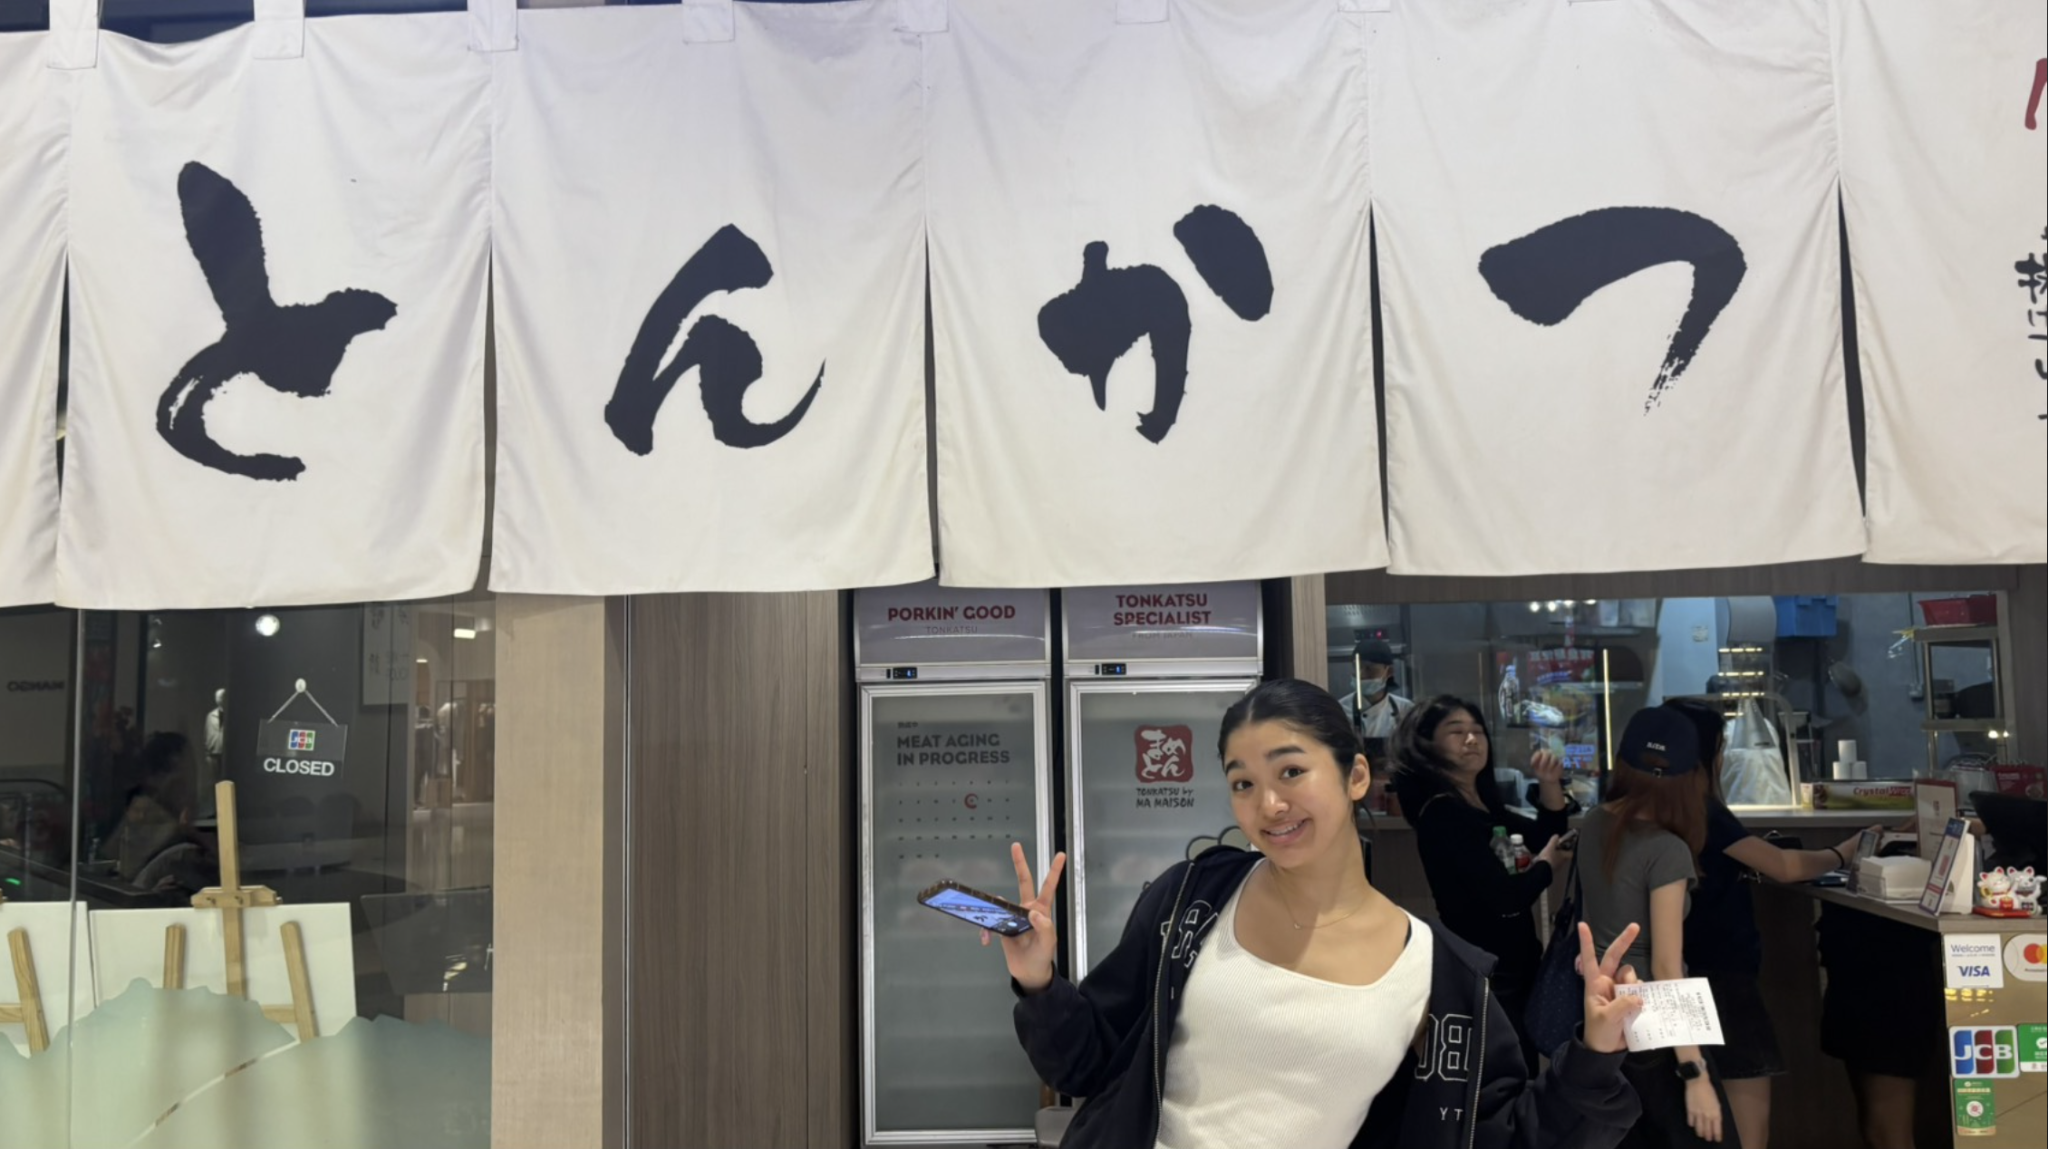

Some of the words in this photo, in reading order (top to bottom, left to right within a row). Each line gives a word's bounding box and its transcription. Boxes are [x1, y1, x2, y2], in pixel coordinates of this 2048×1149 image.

[1116, 593, 1208, 608] TONKATSU
[888, 606, 959, 622] PORKIN'
[963, 605, 1016, 620] GOOD
[1113, 611, 1212, 626] SPECIALIST
[926, 625, 978, 634] TONKATSU
[897, 735, 942, 749] MEAT
[946, 733, 1000, 748] AGING
[897, 752, 915, 766] IN
[919, 750, 1011, 765] PROGRESS
[263, 757, 335, 777] CLOSED
[1136, 787, 1180, 797] TONKATSU
[1182, 786, 1194, 798] by
[1135, 798, 1151, 808] MA
[1154, 797, 1195, 808] MAISON
[1950, 944, 1996, 953] Welcome
[1958, 966, 1991, 977] VISA
